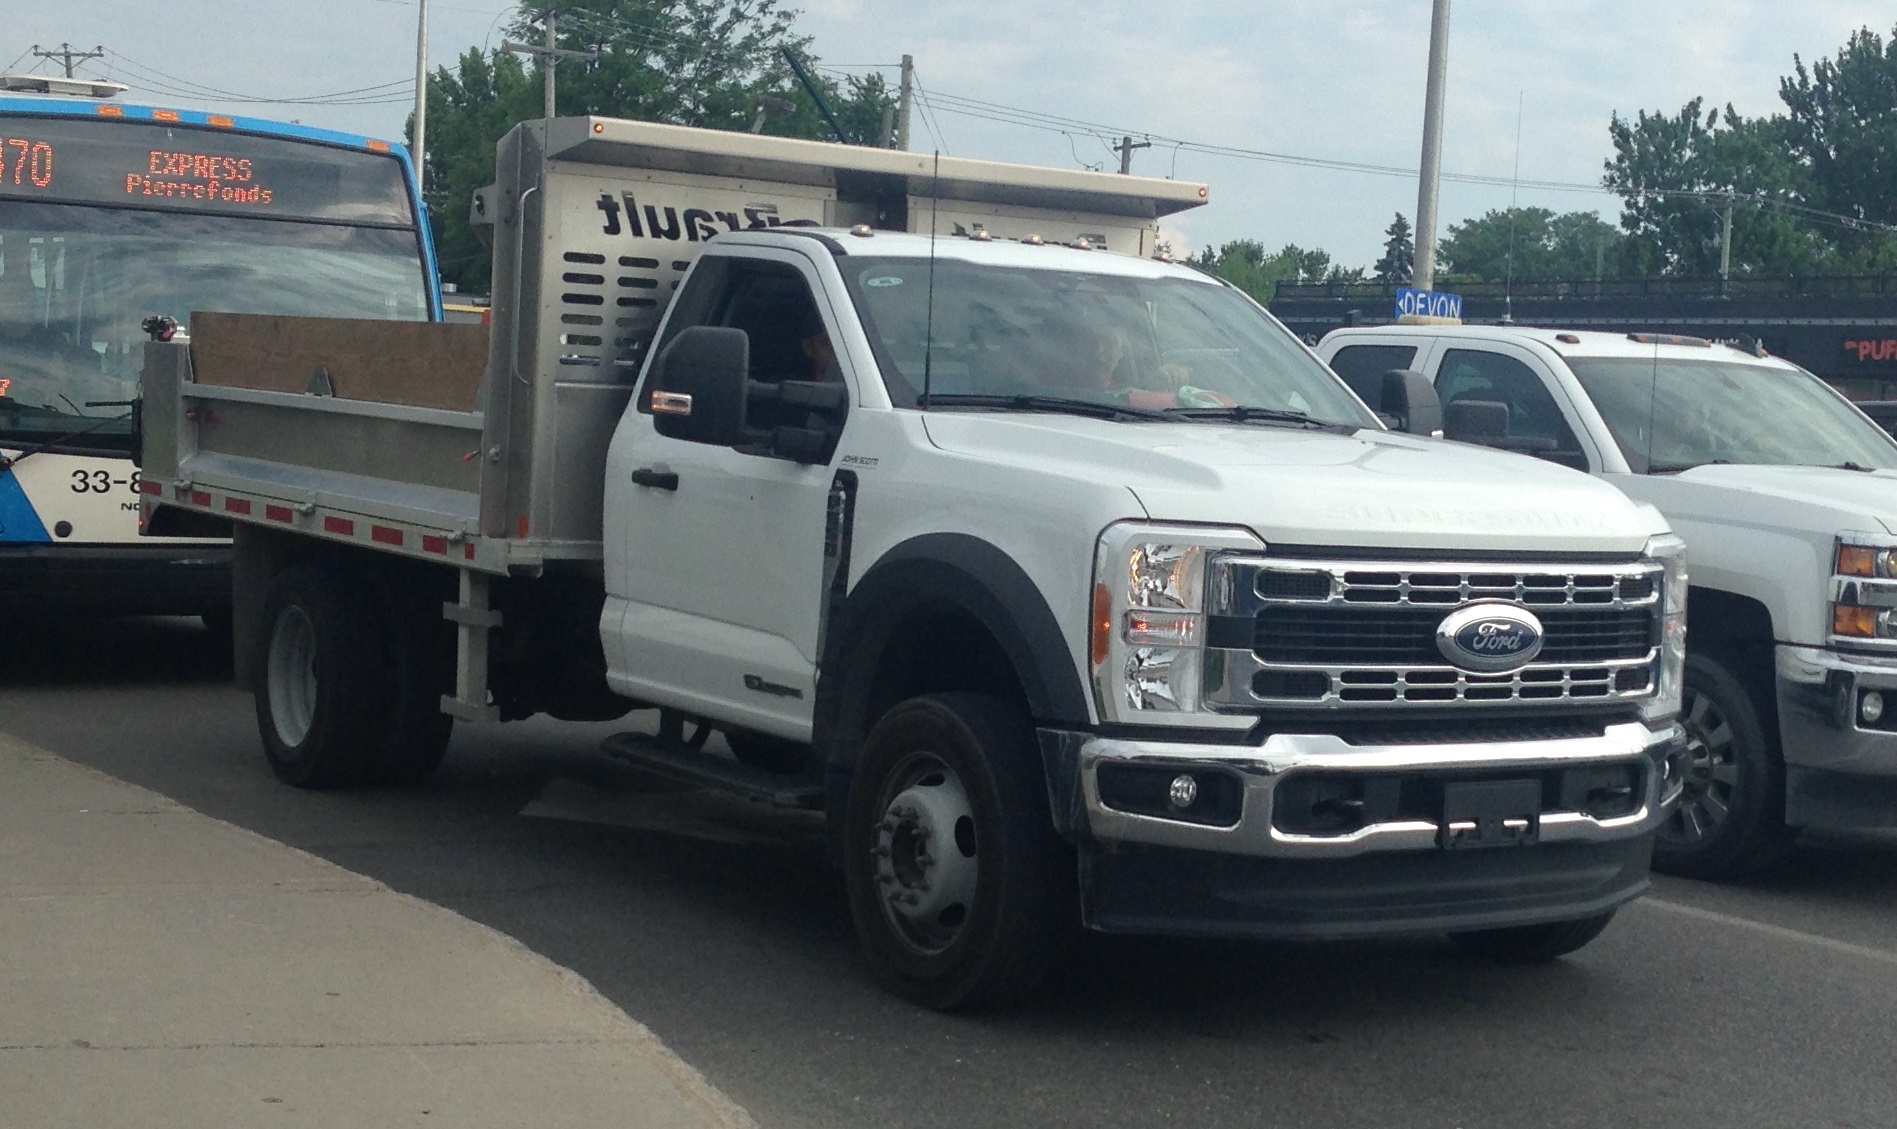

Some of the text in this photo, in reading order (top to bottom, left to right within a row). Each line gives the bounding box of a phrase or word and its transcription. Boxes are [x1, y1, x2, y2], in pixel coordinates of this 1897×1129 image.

[0, 138, 52, 187] 70
[149, 150, 253, 180] EXPRESS
[126, 173, 272, 204] Pierrefonds
[1404, 291, 1461, 318] DEVON
[1473, 623, 1523, 650] Ford
